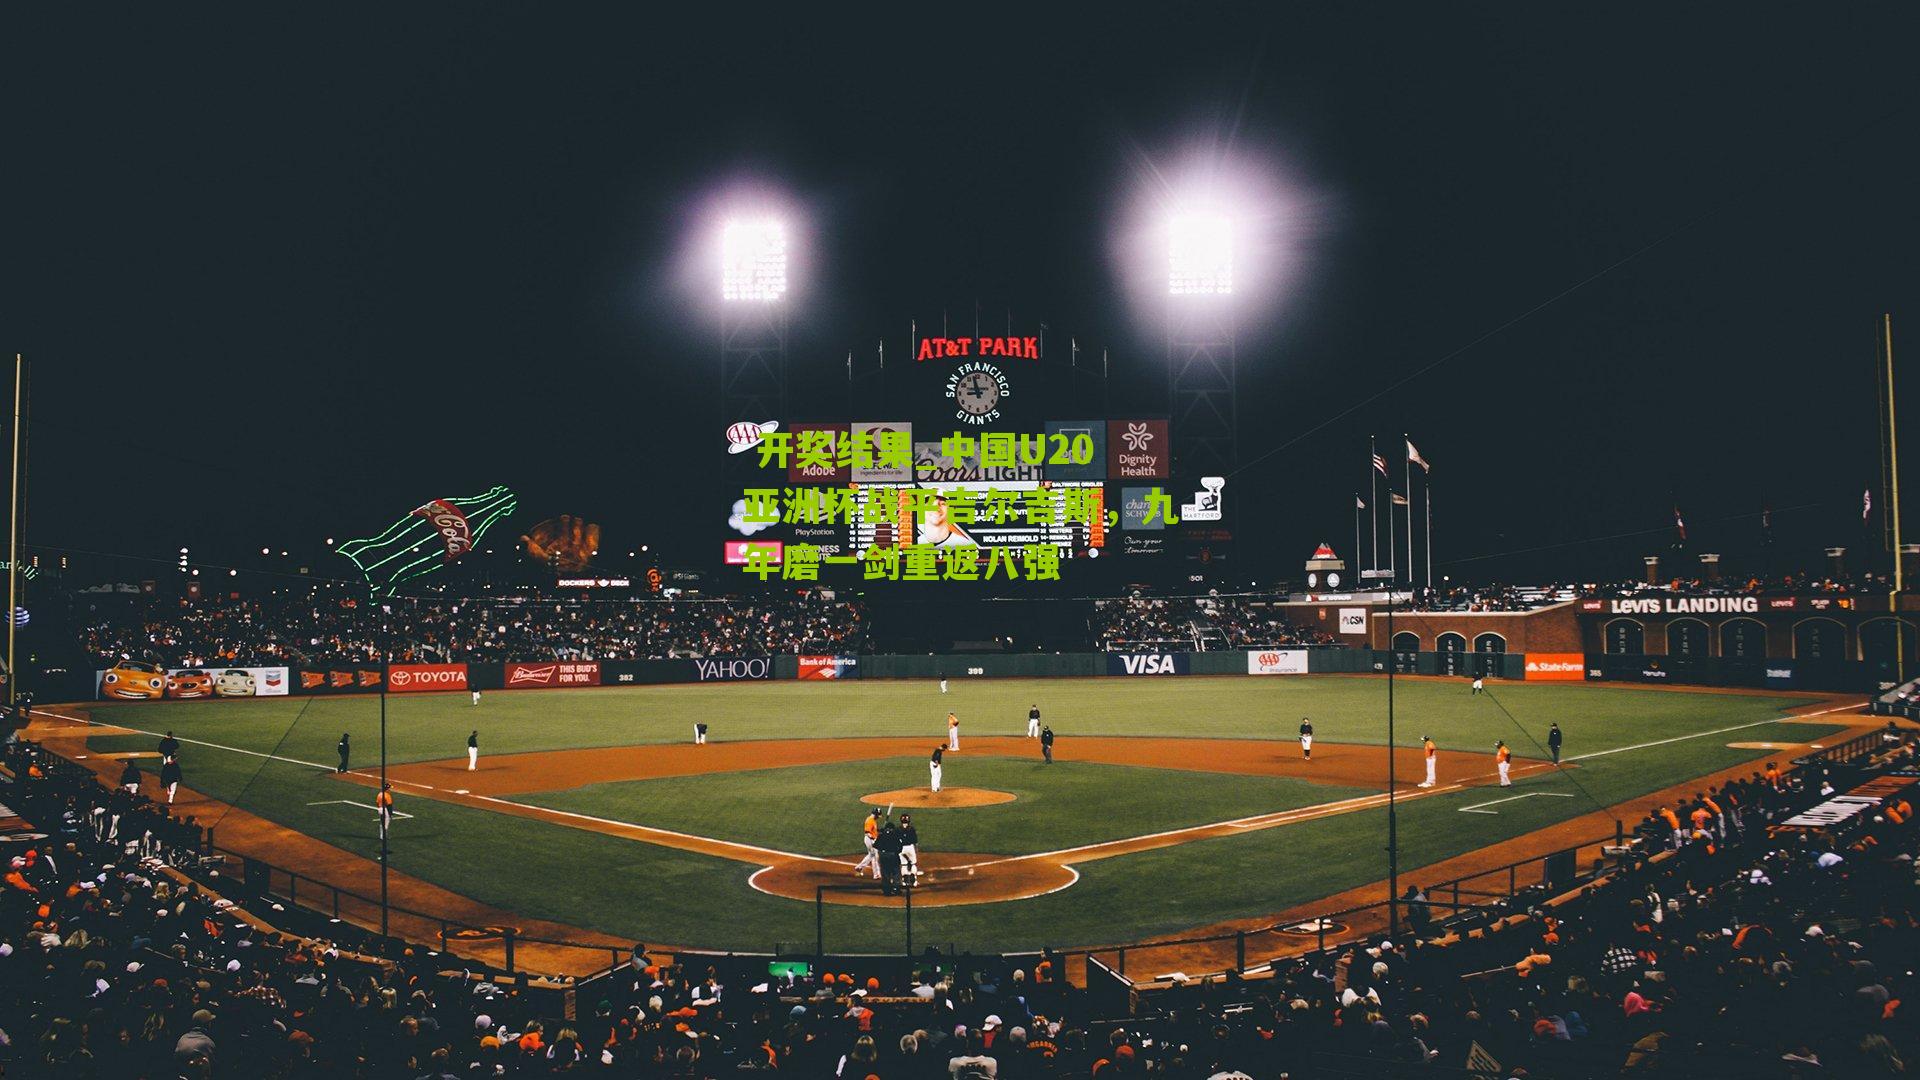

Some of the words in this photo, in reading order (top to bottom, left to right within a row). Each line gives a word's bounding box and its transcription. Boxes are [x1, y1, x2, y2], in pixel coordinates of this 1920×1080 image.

[918, 338, 972, 360] AT&T
[979, 337, 1038, 359] PARK
[946, 373, 959, 398] SAN
[958, 361, 1010, 397] FRANCISCO
[956, 409, 1001, 425] GIANTS
[1119, 454, 1157, 467] Dignity
[914, 459, 981, 482] Coors
[984, 466, 1044, 481] LIGHT
[1121, 466, 1156, 476] Health
[795, 529, 834, 537] PlayStation
[1666, 597, 1758, 613] LANDING
[1350, 616, 1365, 626] CSN
[559, 665, 575, 673] THIS
[576, 664, 597, 672] BUD'S
[695, 658, 770, 681] YAHOO!
[1119, 655, 1175, 674] VISA
[413, 671, 467, 683] TOYOTA
[559, 674, 573, 682] FOR
